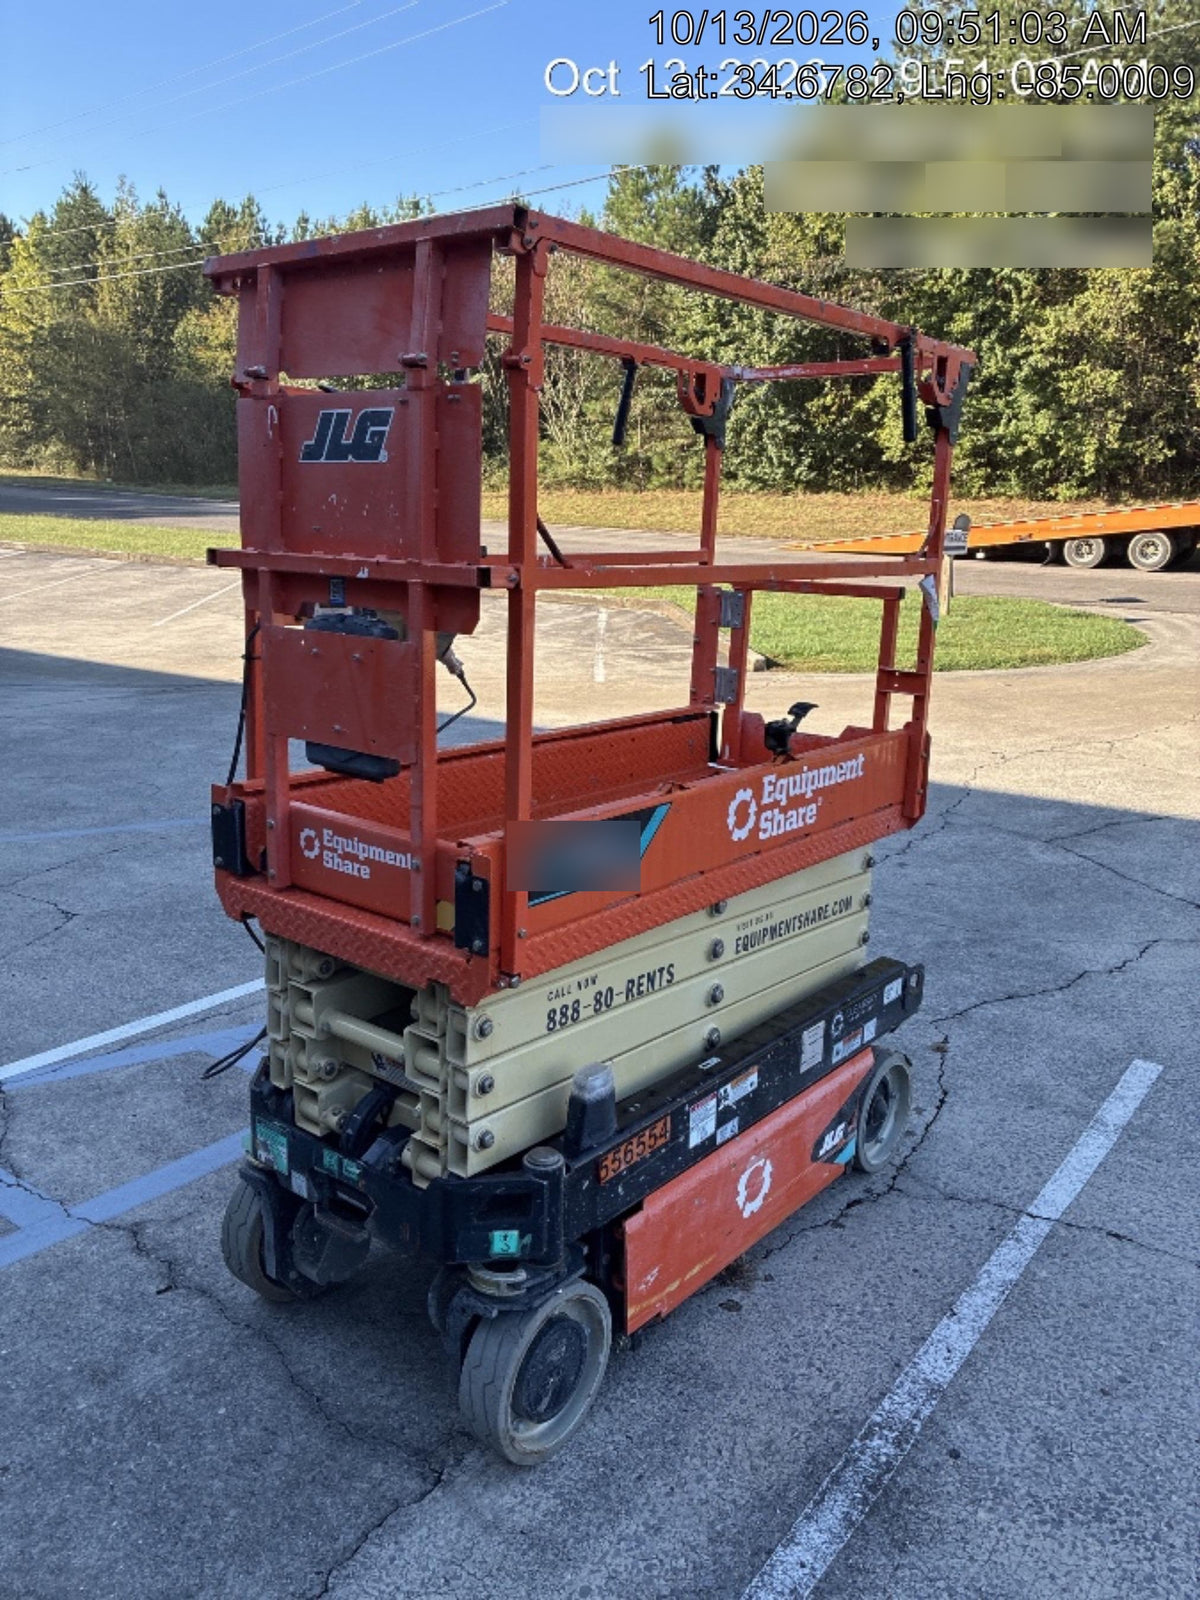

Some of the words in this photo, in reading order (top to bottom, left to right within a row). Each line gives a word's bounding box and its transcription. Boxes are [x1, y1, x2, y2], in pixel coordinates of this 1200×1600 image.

[299, 406, 395, 463] JLG
[761, 753, 865, 806] Equipment
[759, 803, 818, 840] Share
[323, 850, 371, 880] Share
[735, 895, 853, 955] EQUIPMENTSHARE.COM
[546, 963, 675, 1032] 888-80-RENTS
[547, 985, 572, 1001] CALL
[818, 1121, 847, 1158] JLG
